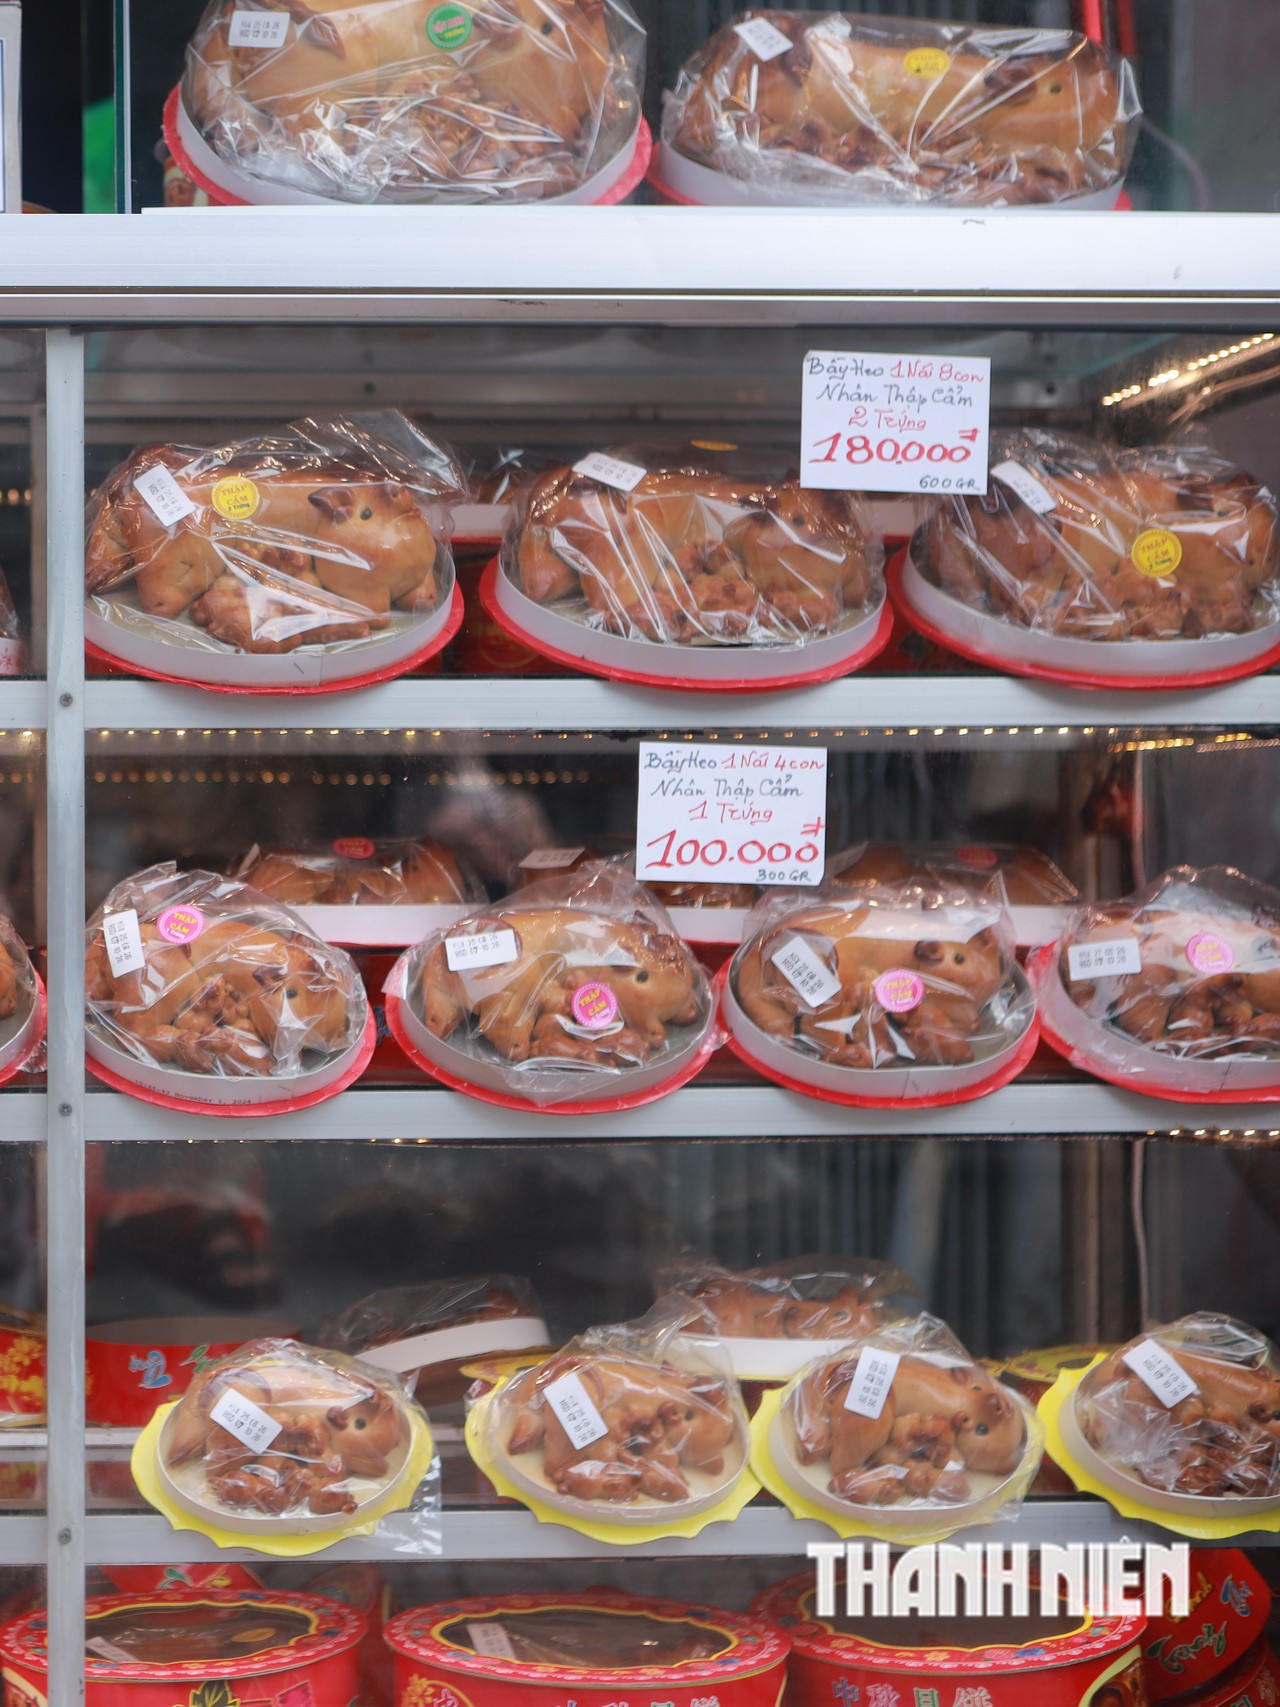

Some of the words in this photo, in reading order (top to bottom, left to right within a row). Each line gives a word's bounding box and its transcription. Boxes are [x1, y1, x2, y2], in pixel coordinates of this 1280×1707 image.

[939, 364, 952, 381] 8
[954, 373, 984, 383] con
[849, 405, 867, 427] 2
[688, 751, 716, 769] Heo
[775, 754, 784, 771] 4
[789, 759, 825, 770] con
[714, 778, 754, 803] Thập
[689, 801, 708, 821] 1
